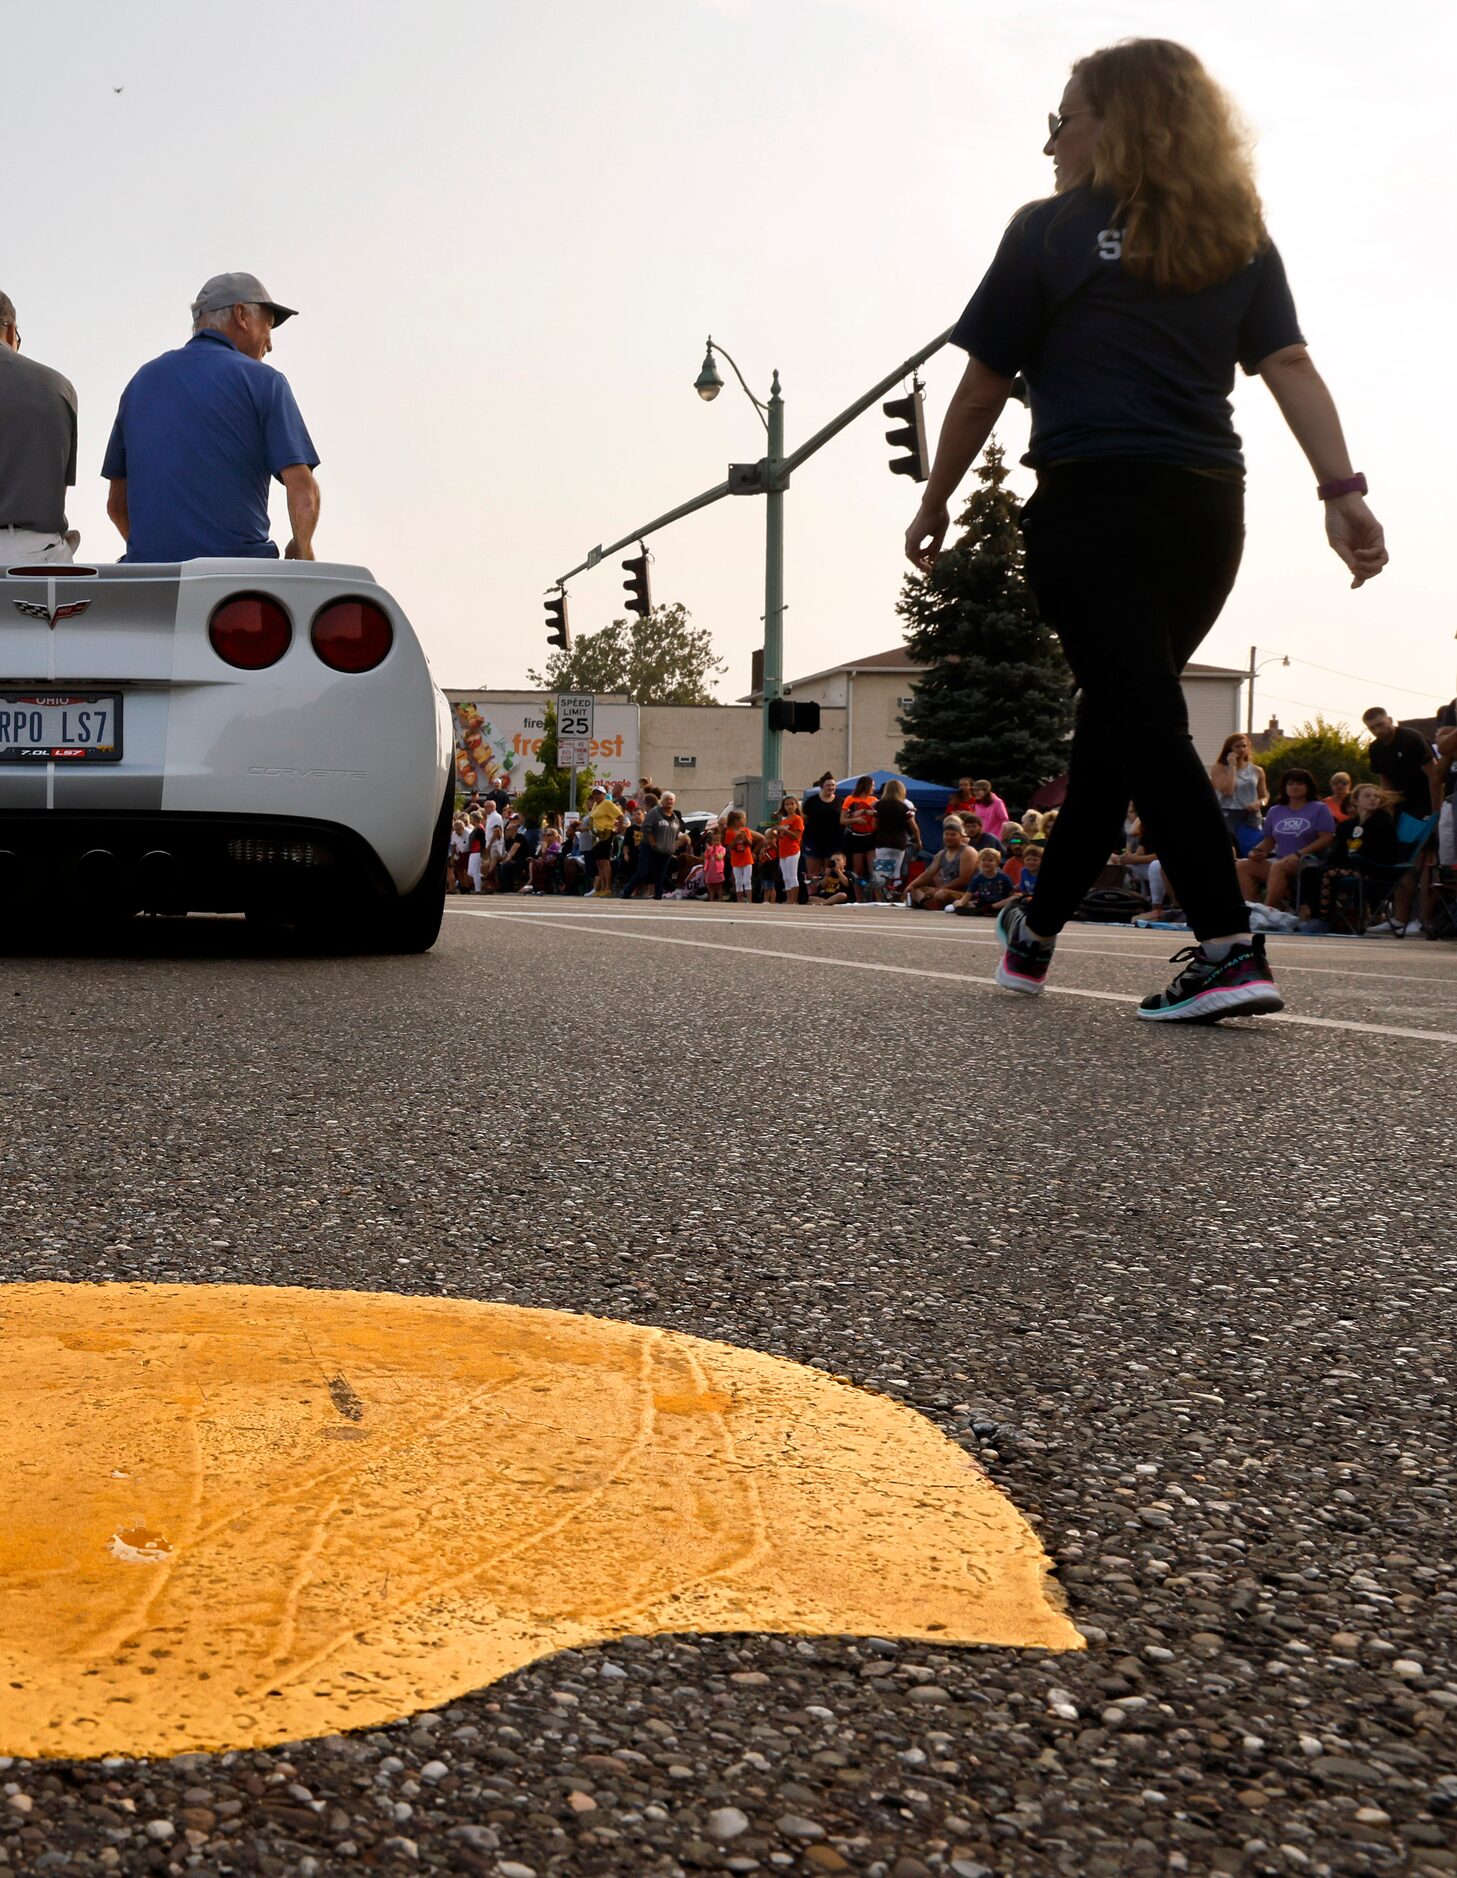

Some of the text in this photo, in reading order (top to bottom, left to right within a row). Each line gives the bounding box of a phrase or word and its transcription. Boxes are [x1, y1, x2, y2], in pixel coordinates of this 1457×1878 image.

[560, 698, 591, 708] SPEED
[563, 708, 588, 716] LIMIT
[61, 711, 107, 743] LS7
[560, 717, 590, 734] 25
[247, 766, 369, 780] CORVETTE
